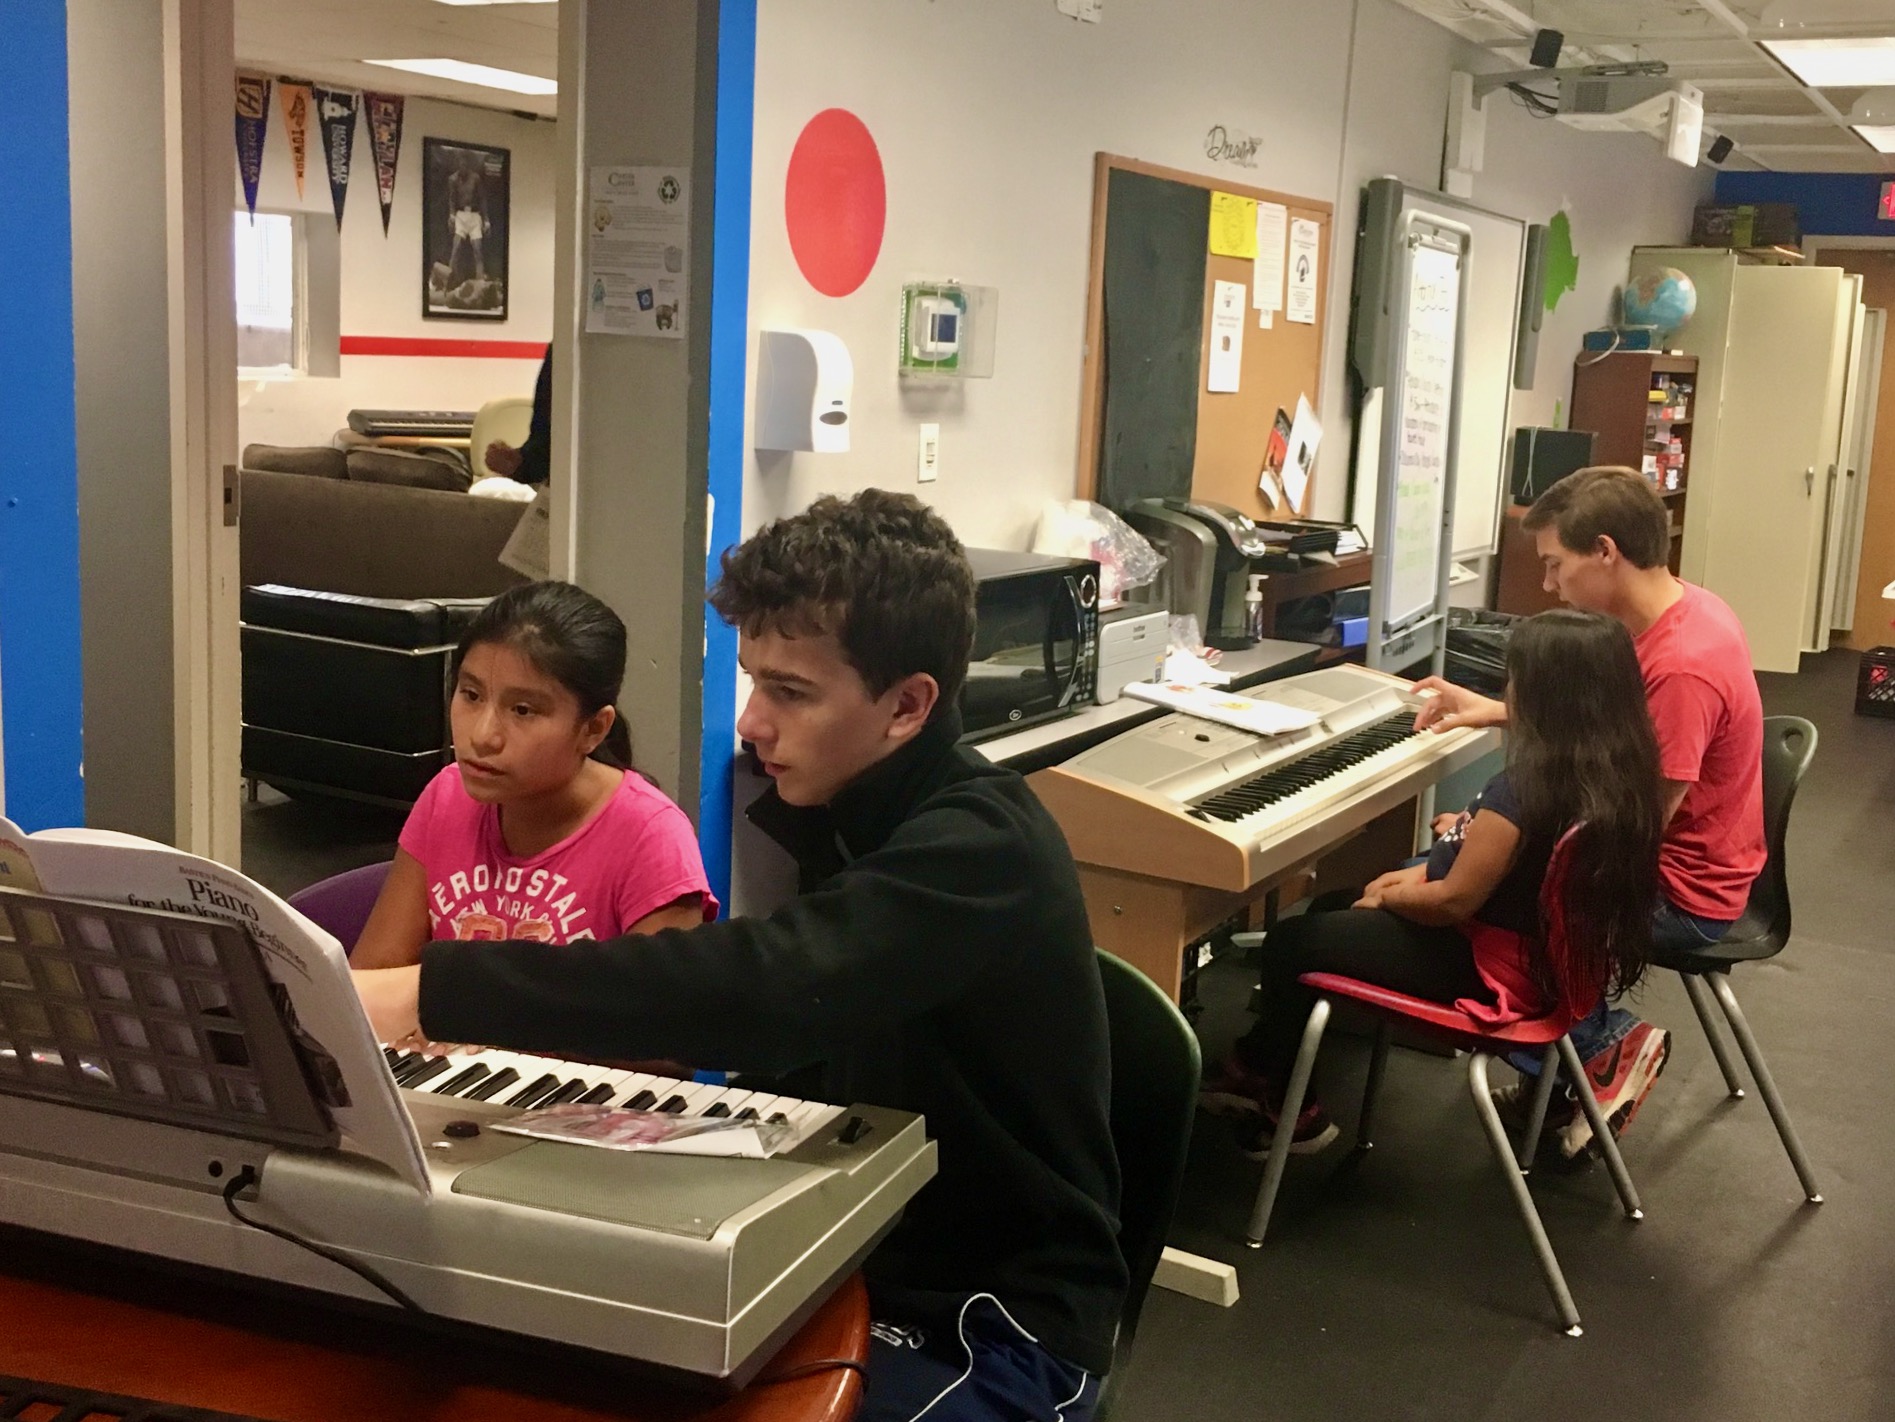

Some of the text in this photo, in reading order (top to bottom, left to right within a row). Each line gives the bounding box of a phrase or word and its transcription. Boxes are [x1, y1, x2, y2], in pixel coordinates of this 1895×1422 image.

[291, 130, 305, 178] TOWSON
[338, 124, 349, 185] HOWARD
[128, 894, 155, 908] for
[160, 898, 191, 914] the
[185, 877, 260, 921] Piano
